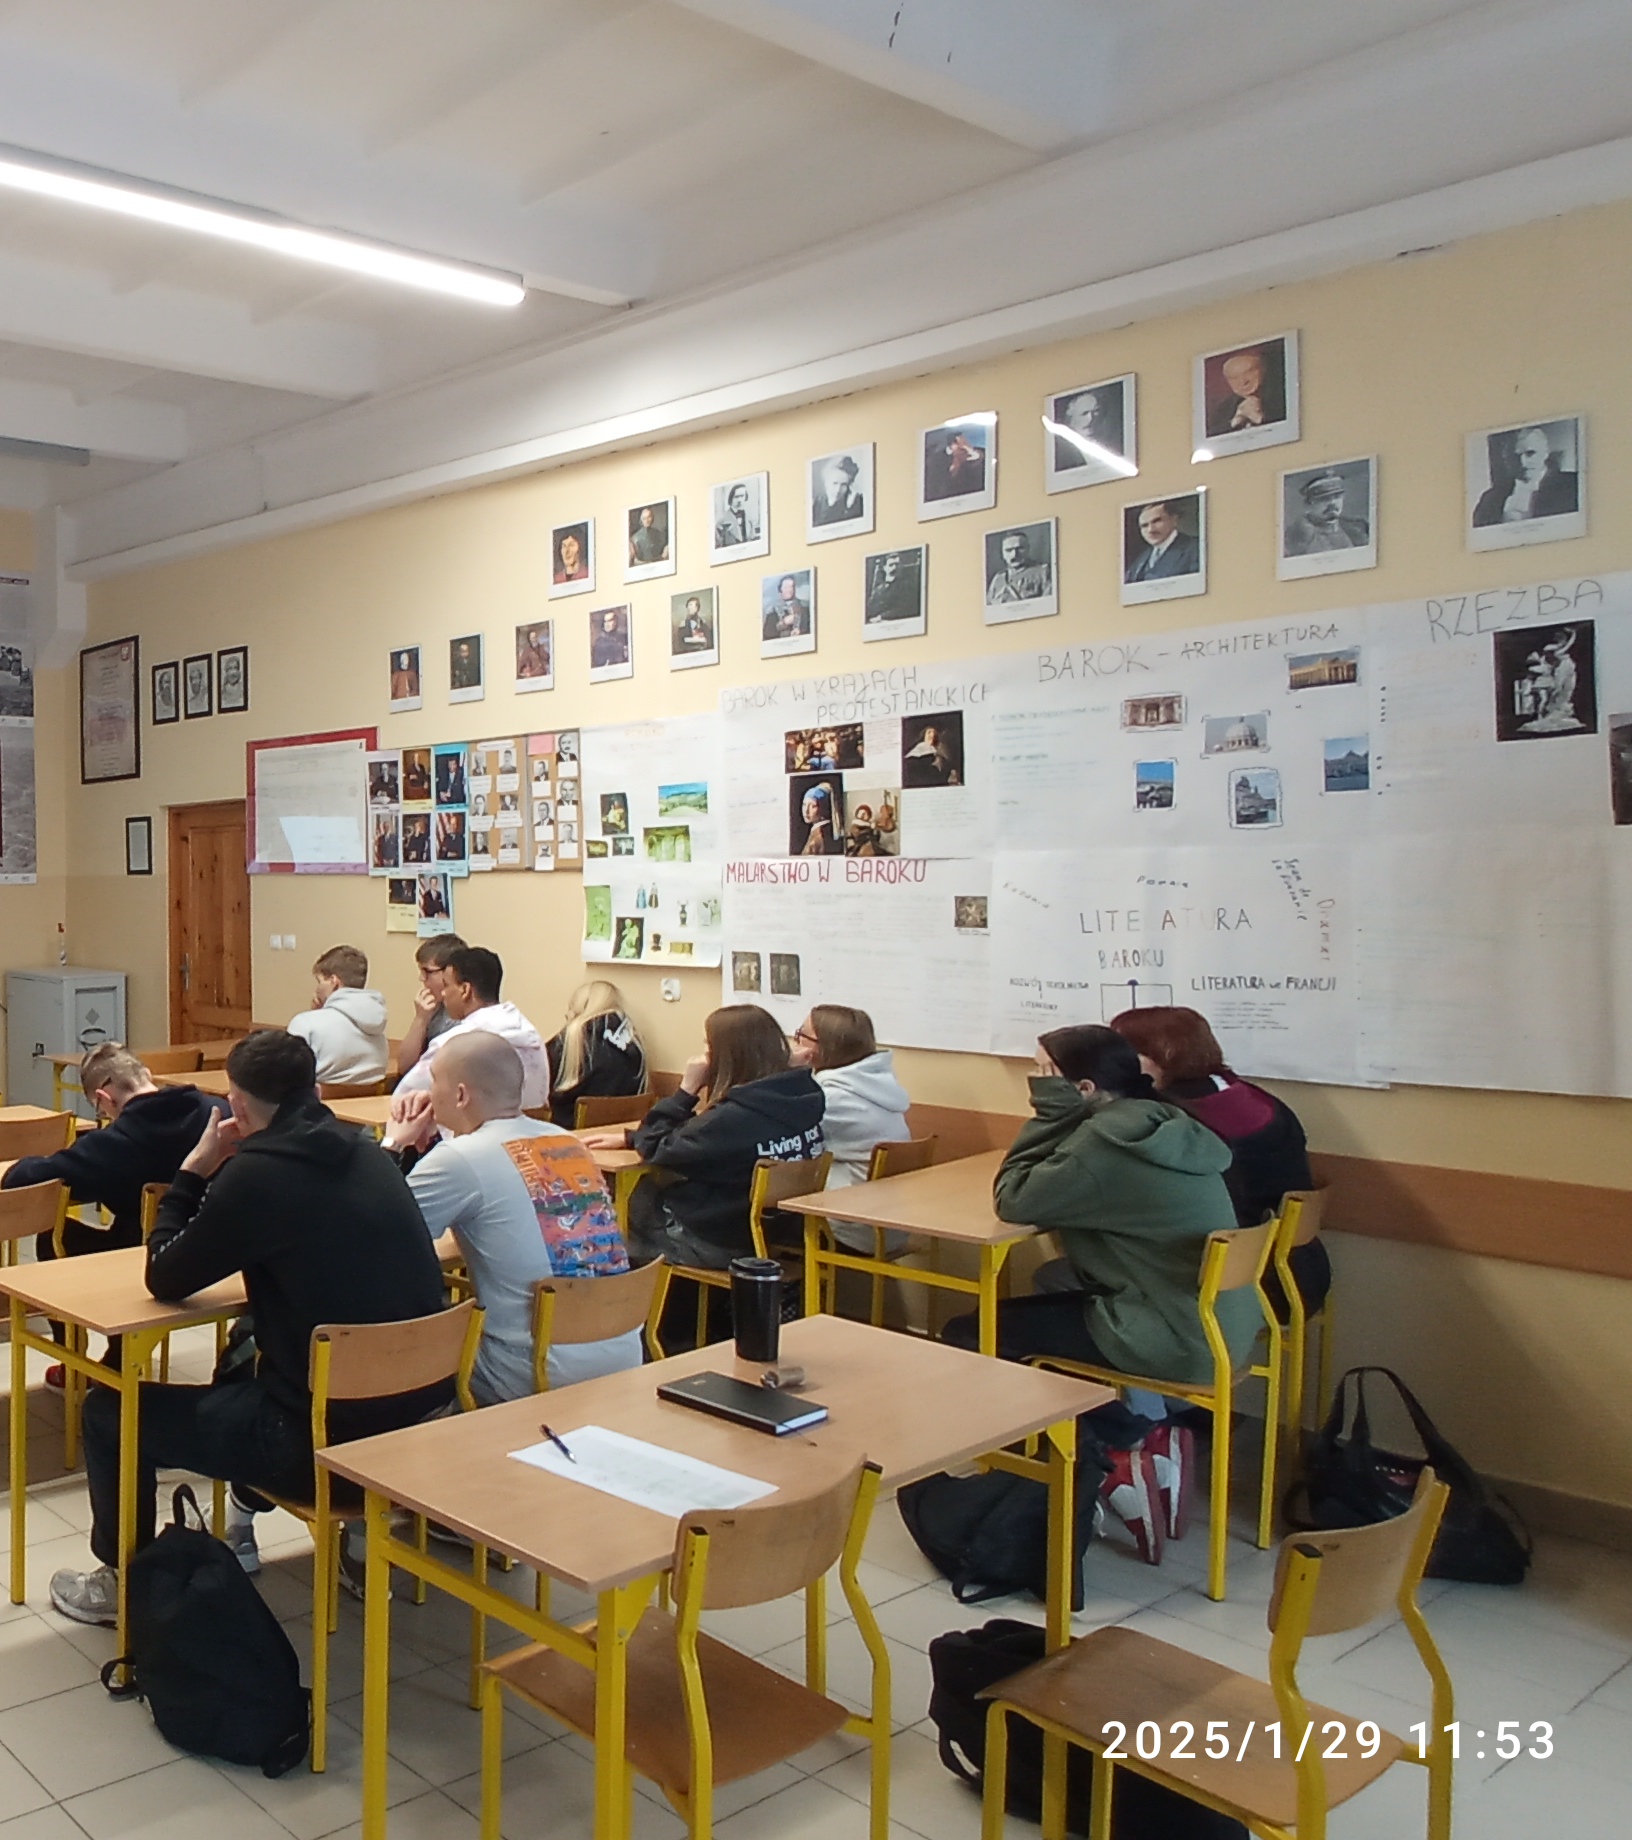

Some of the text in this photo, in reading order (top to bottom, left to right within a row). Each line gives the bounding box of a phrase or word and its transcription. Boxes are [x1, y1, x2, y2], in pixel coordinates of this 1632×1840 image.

[1037, 644, 1149, 683] BAROK
[1180, 623, 1339, 661] ARCHITEKTURA
[792, 684, 806, 701] W
[814, 666, 917, 702] KRAJACH
[818, 859, 831, 884] W
[1079, 907, 1253, 934] LITEATURA
[1098, 949, 1165, 969] BAROKU
[1191, 975, 1266, 991] LITERATURA
[756, 1135, 803, 1156] Living
